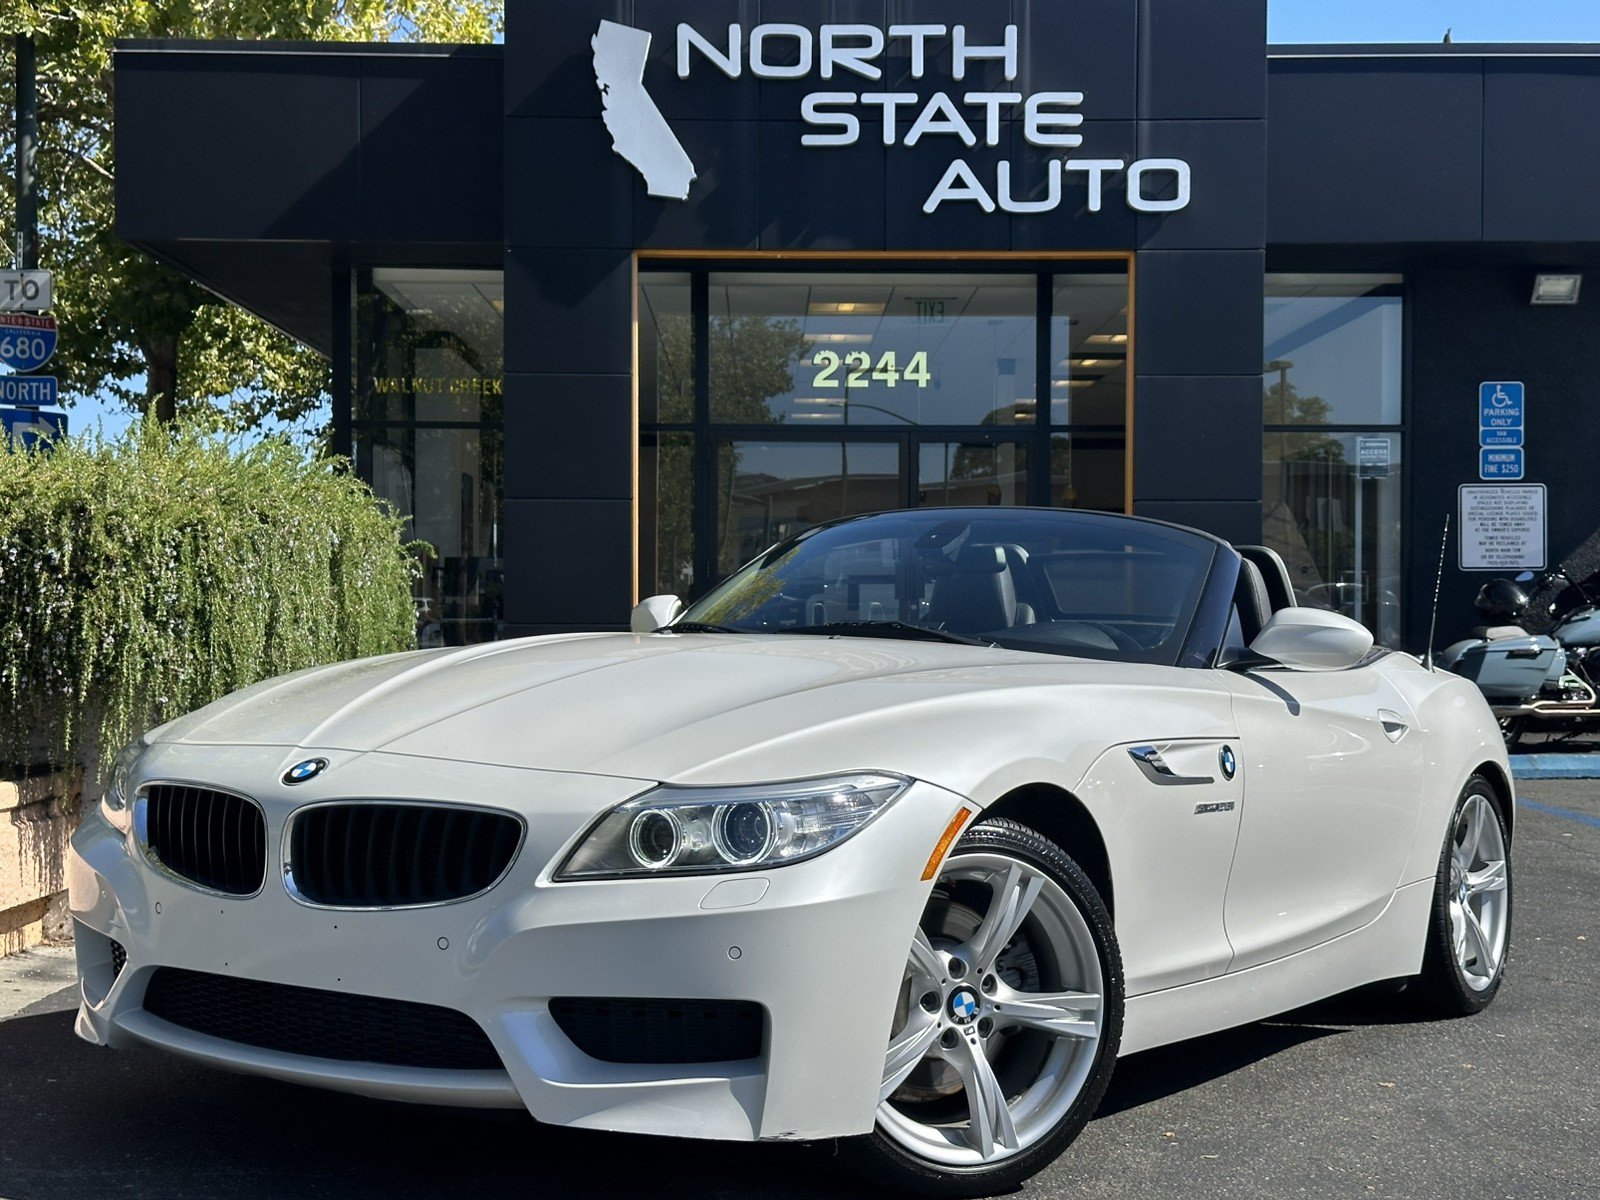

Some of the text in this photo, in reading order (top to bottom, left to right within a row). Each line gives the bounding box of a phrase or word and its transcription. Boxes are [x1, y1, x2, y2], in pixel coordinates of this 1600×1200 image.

[677, 23, 1017, 80] NORTH
[801, 92, 1083, 147] STATE
[923, 159, 1191, 213] AUTO
[4, 279, 40, 301] TO
[0, 315, 50, 328] NTERSTATE
[5, 328, 41, 336] CALIFORNIA
[0, 336, 46, 361] 680
[812, 350, 931, 388] 2244
[373, 377, 502, 395] WALNUT CREEK
[1483, 408, 1519, 416] PARKING
[1490, 418, 1512, 426] ONLY
[1488, 453, 1515, 462] MINIMUM
[1484, 464, 1519, 473] FINE $250
